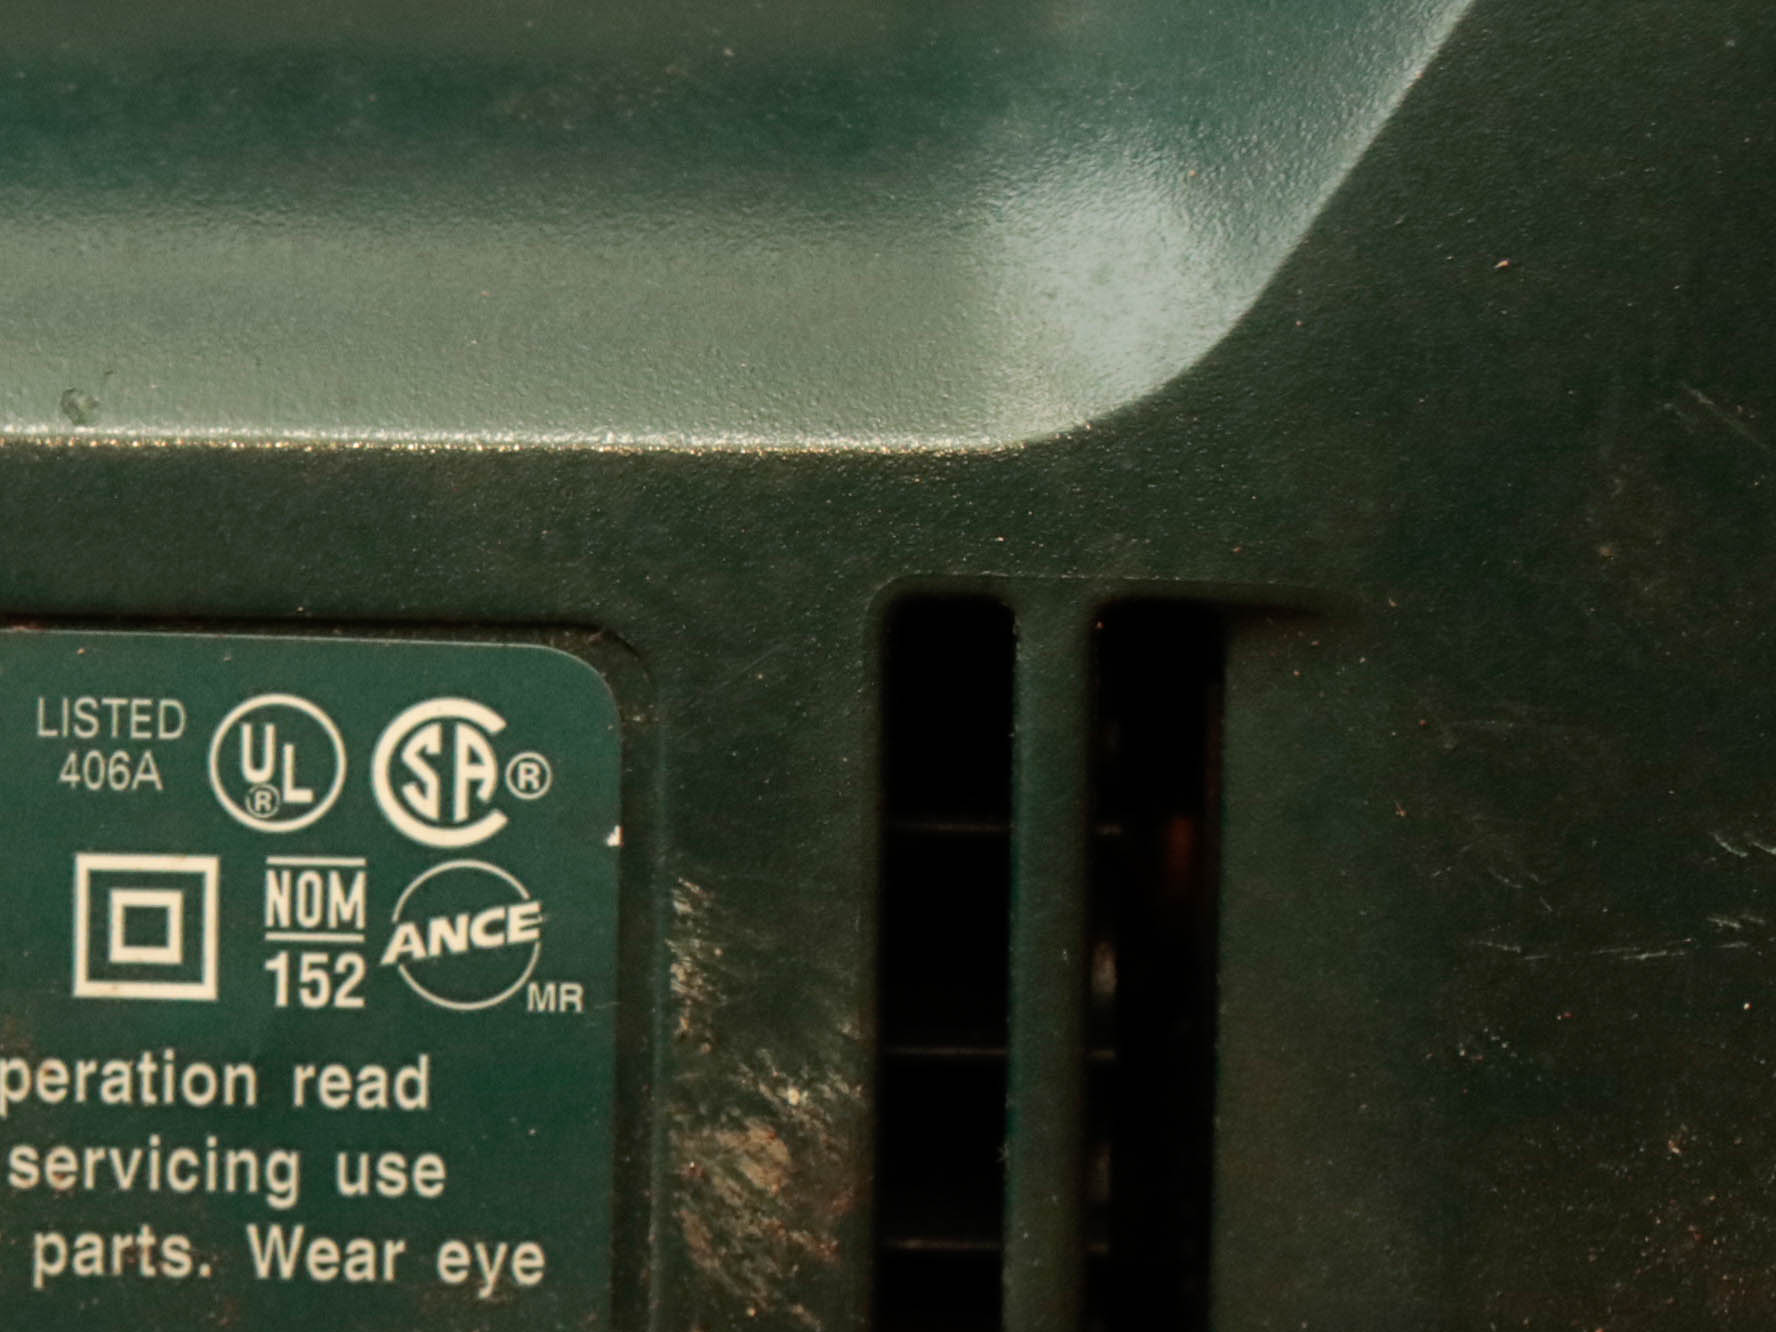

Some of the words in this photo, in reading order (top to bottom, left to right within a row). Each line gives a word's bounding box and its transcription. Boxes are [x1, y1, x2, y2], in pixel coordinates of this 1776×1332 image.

[36, 695, 186, 741] LISTED
[58, 749, 163, 792] 406A
[265, 870, 365, 929] NOM
[378, 900, 541, 966] ANCE
[264, 950, 366, 1009] 152
[527, 981, 583, 1013] MR
[293, 1053, 429, 1111] read
[8, 1134, 299, 1210] servicing
[336, 1152, 446, 1198] use
[33, 1224, 211, 1289] parts.
[246, 1223, 406, 1282] Wear
[436, 1239, 545, 1299] eye
